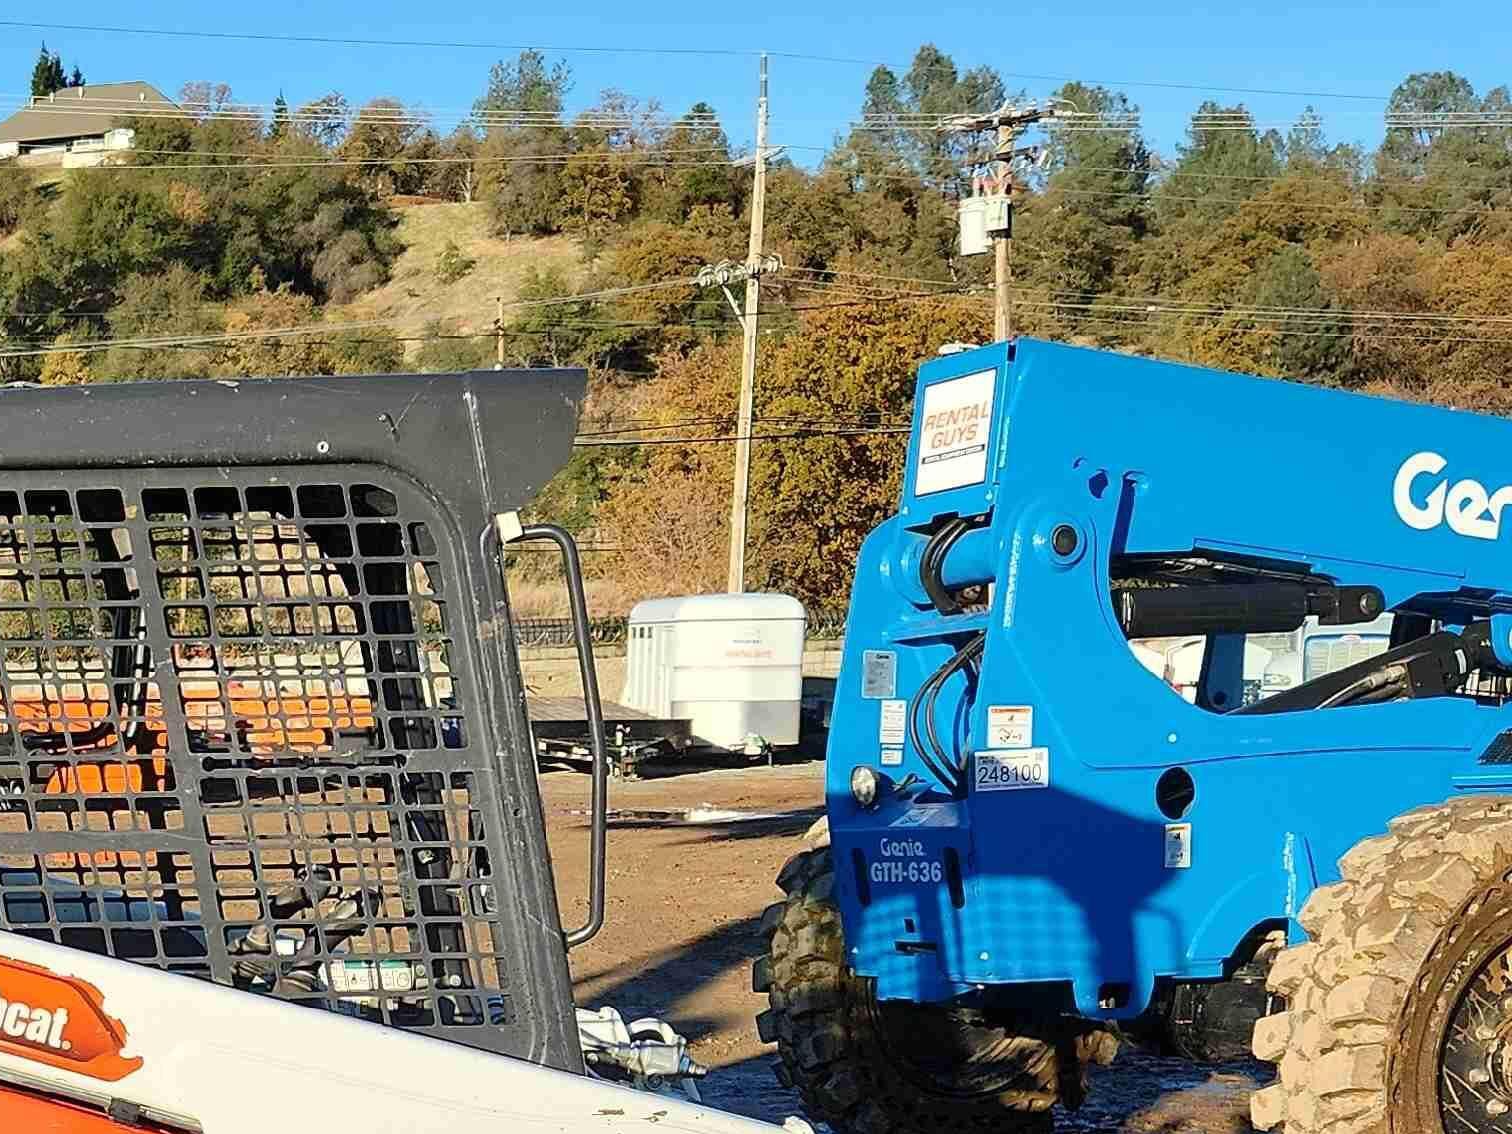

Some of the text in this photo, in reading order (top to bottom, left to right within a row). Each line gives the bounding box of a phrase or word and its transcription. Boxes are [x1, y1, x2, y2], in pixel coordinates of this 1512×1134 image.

[924, 401, 988, 431] RENTAL
[932, 424, 978, 448] GUYS
[978, 763, 1042, 784] 248100
[871, 861, 943, 882] GTH-636
